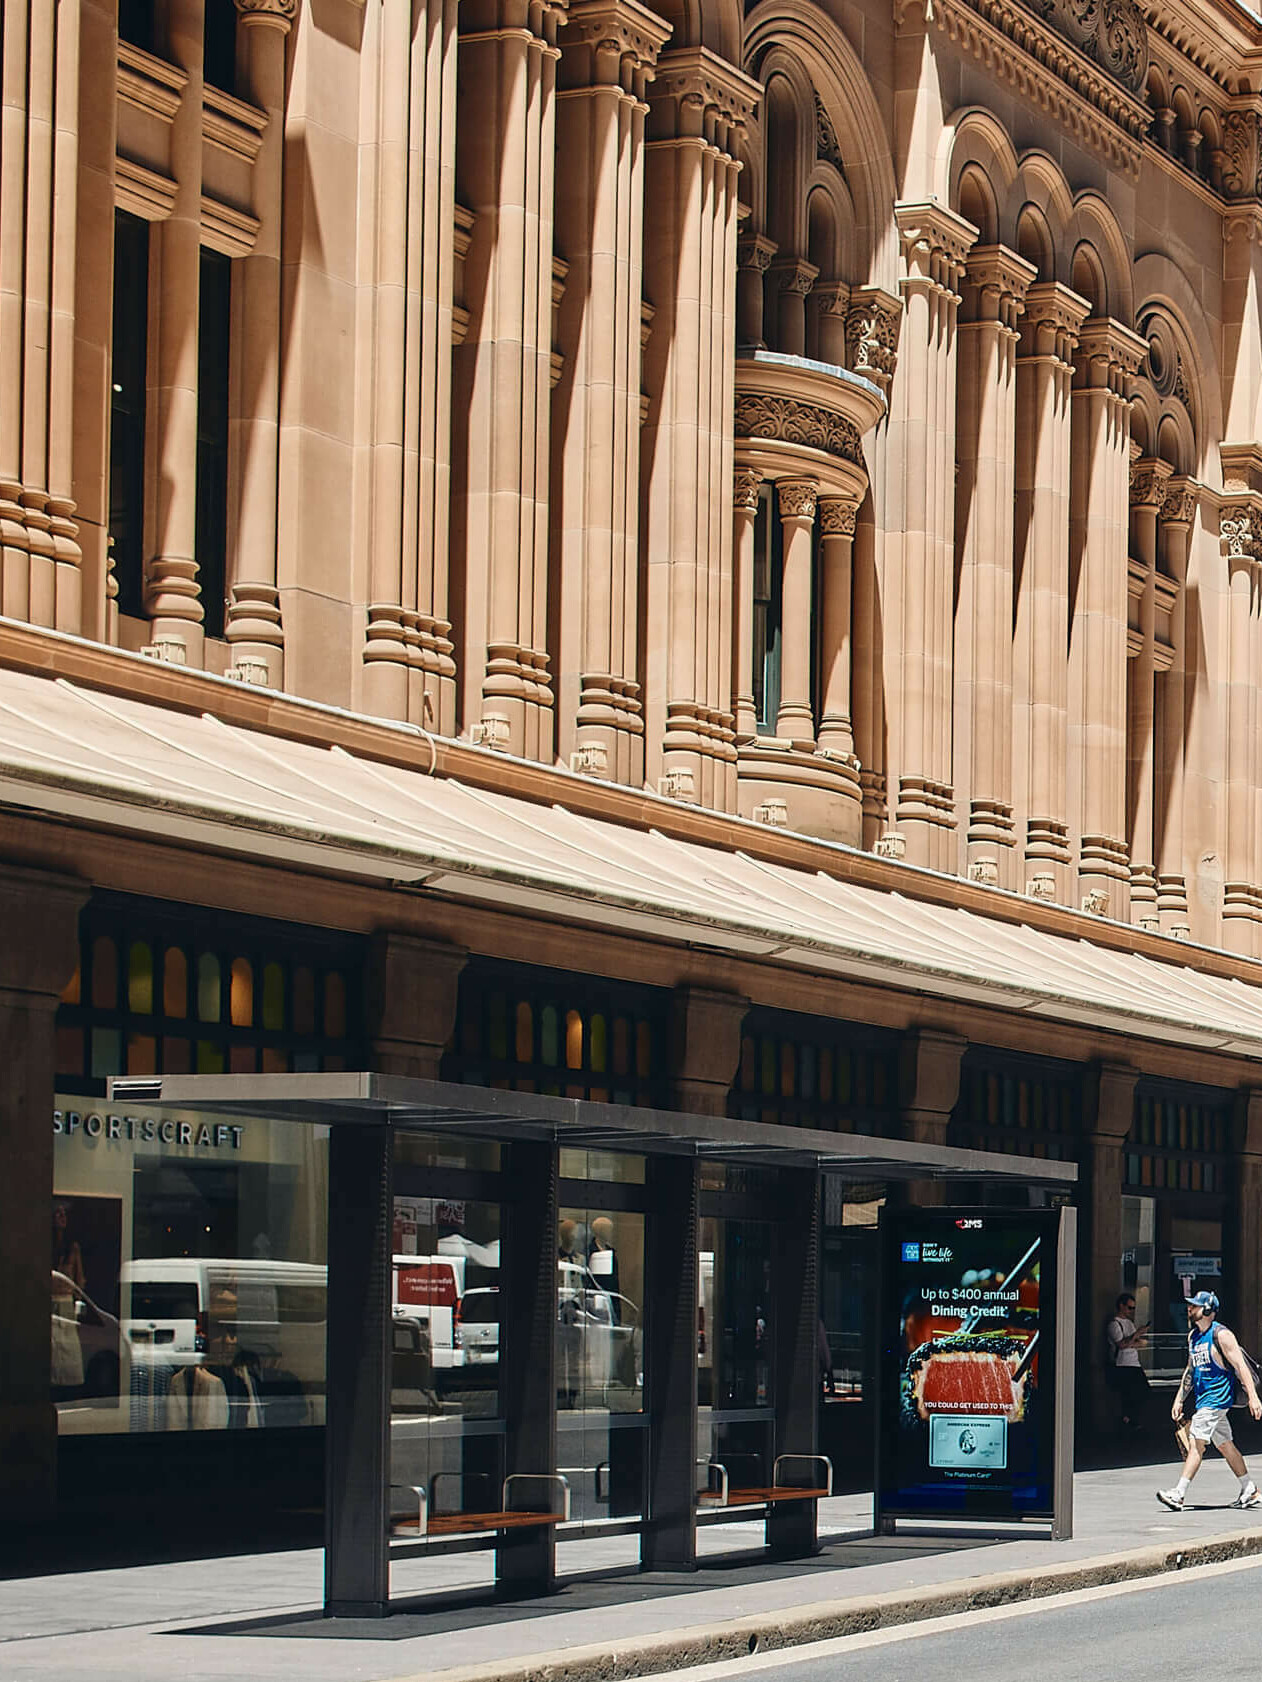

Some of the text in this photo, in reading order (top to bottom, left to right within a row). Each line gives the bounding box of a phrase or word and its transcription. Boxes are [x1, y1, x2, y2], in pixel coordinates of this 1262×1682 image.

[53, 1110, 244, 1149] SPORTSCRAFT
[921, 1287, 1020, 1302] Up to $400 annual
[931, 1304, 968, 1319] Dining
